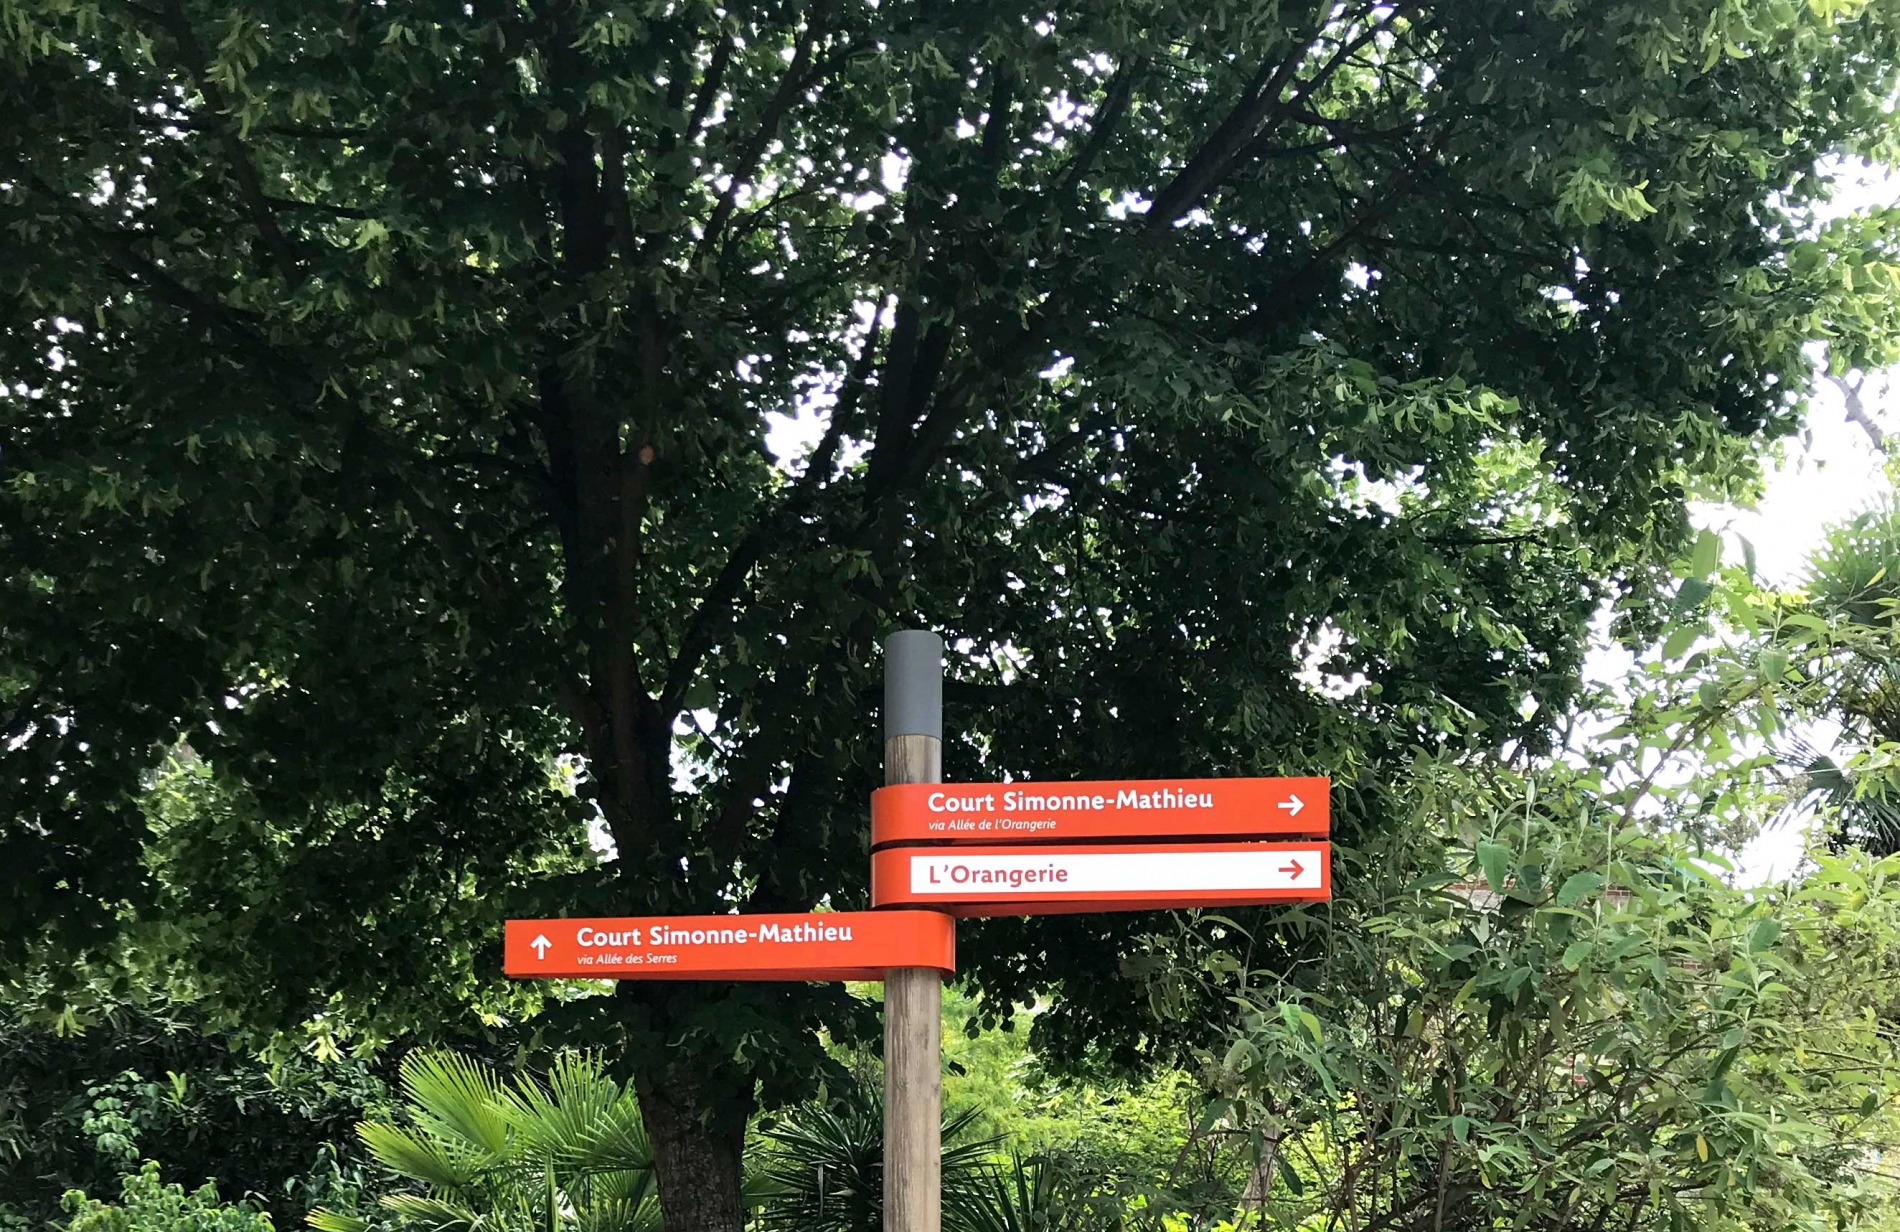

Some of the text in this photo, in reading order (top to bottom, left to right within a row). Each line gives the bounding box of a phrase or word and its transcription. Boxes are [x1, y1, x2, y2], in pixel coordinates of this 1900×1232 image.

[927, 787, 1214, 813] Court Simonne-Mathieu
[928, 817, 1057, 833] via Allée de l'Orangerie
[929, 863, 1068, 888] L'Orangerie
[576, 921, 853, 947] Court Simonne-Mathieu
[577, 952, 678, 965] via Allée des Serres
